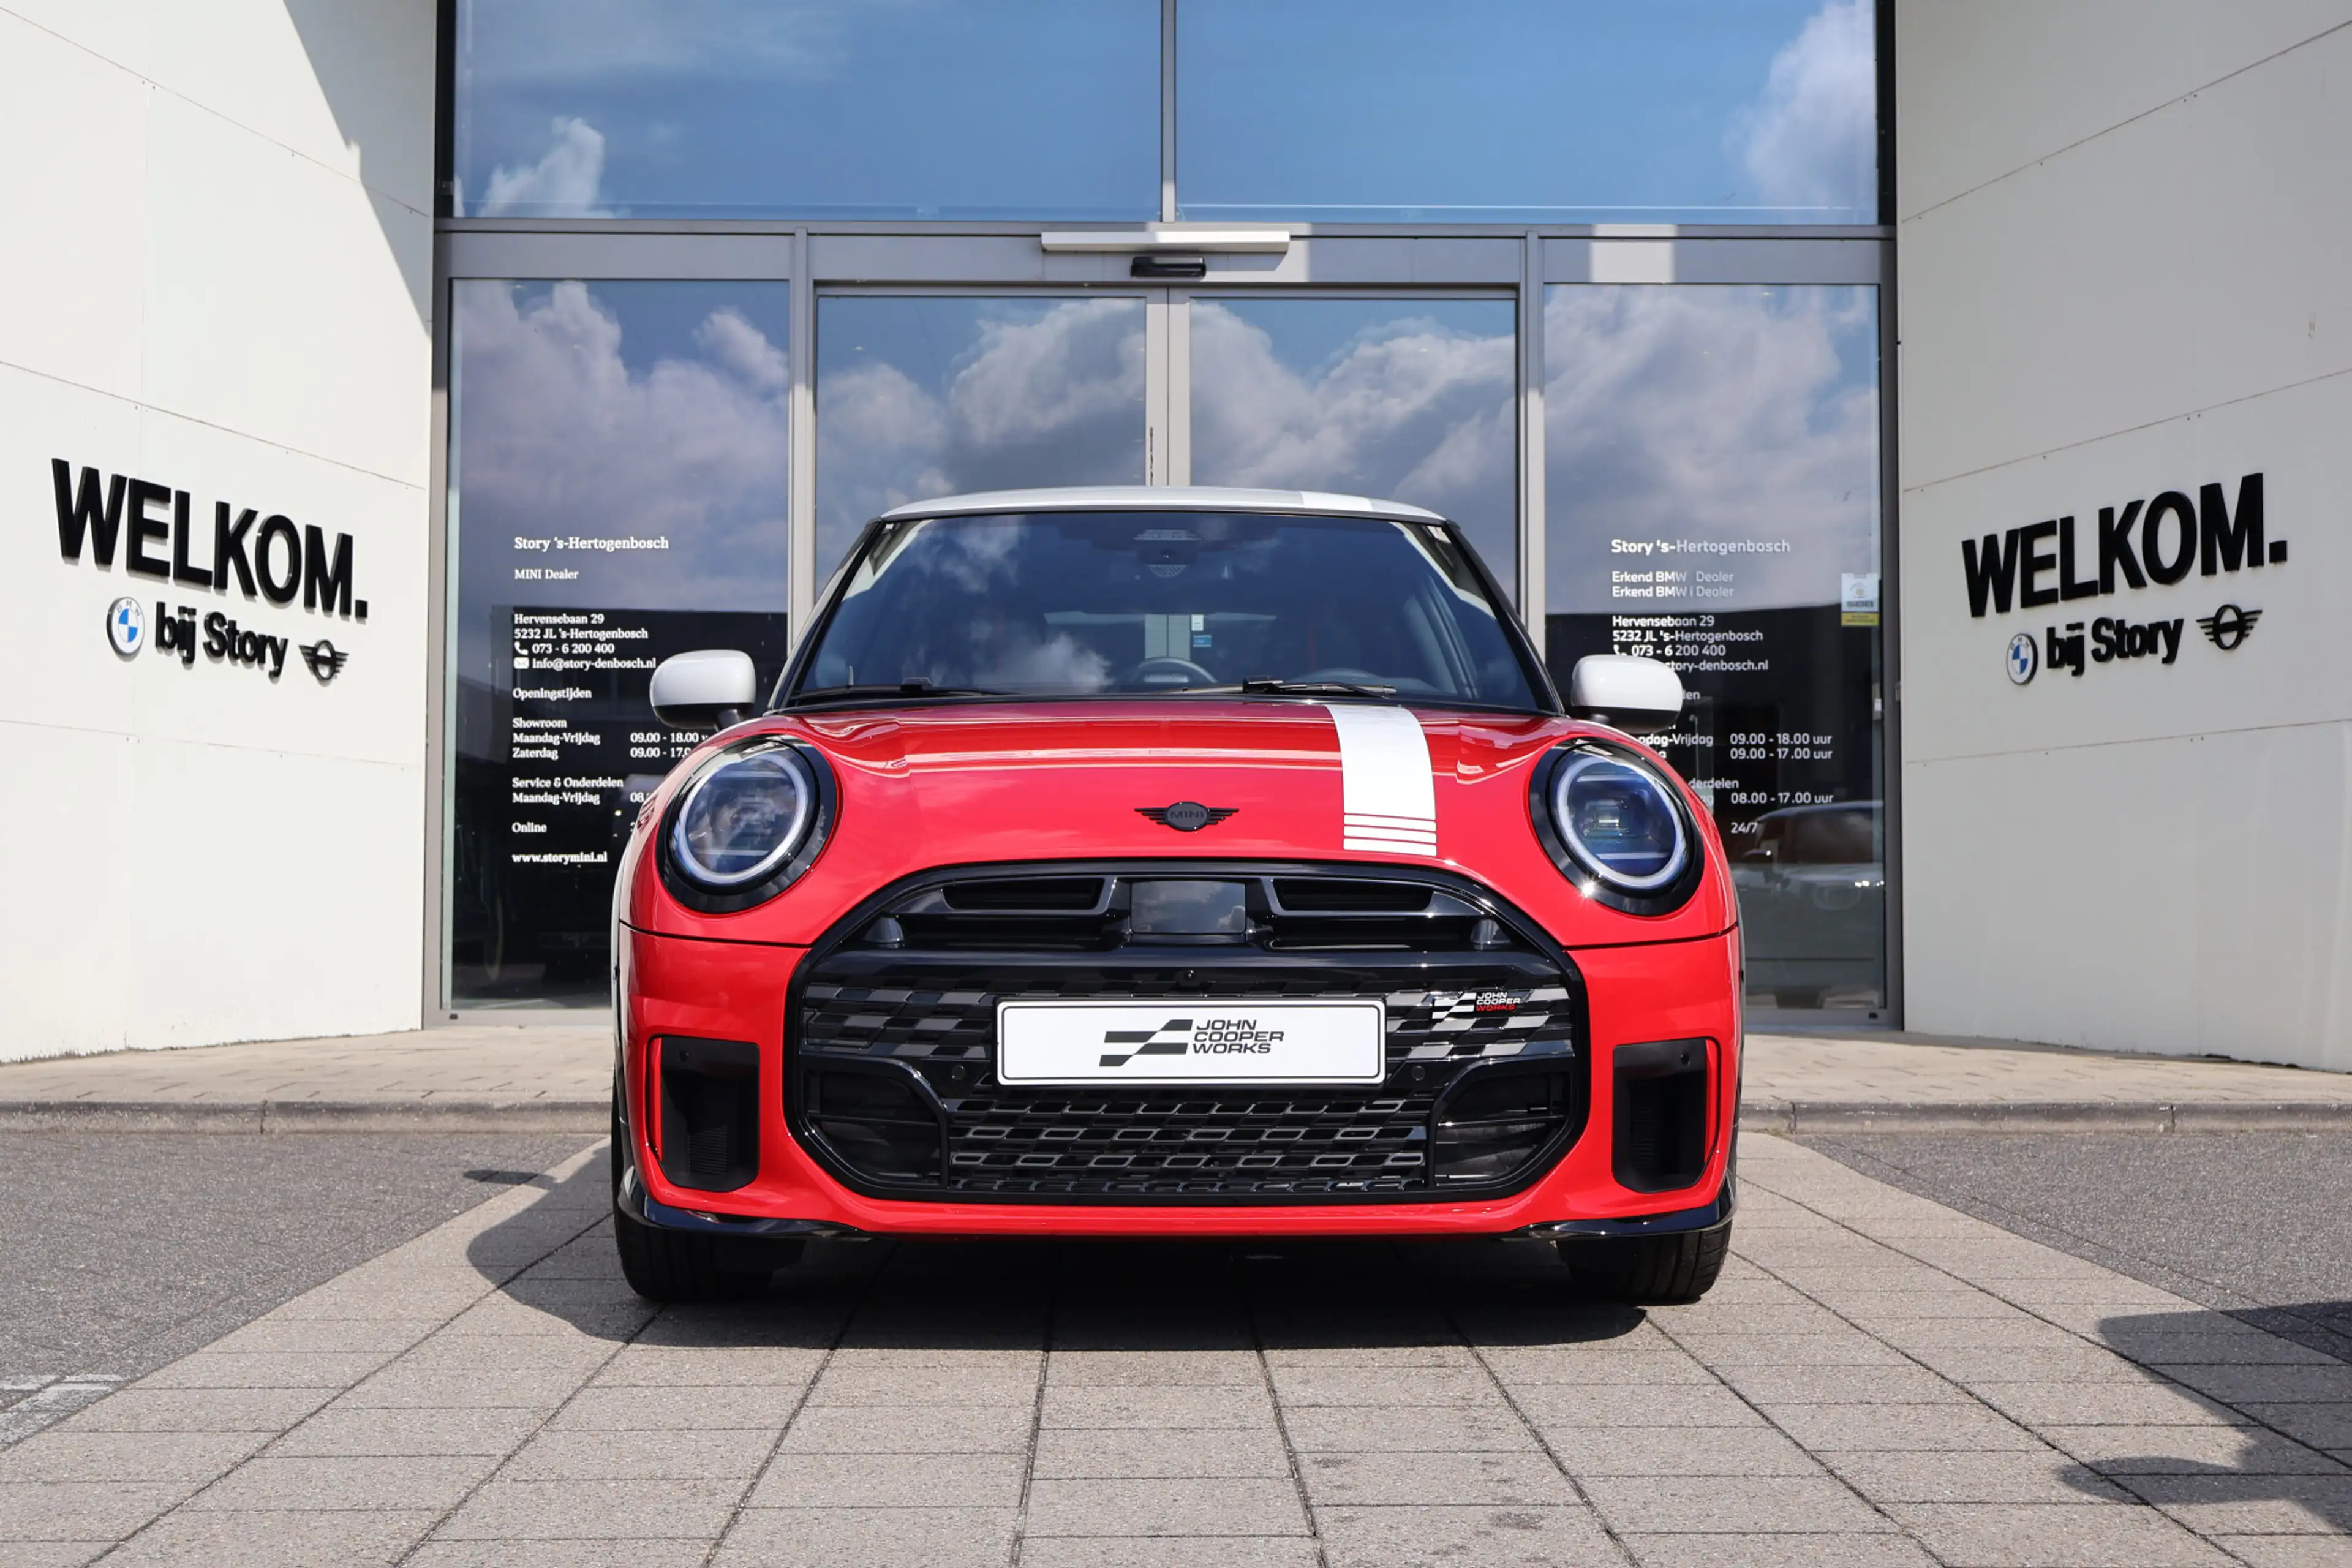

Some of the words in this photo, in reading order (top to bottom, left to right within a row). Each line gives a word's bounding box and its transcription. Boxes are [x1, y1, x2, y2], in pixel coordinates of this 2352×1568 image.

[51, 458, 368, 619] WELKOM.
[514, 537, 551, 552] Story
[1611, 539, 1654, 556] Story
[1656, 539, 1790, 555] 's-Hertogenbosch
[1962, 472, 2288, 618] WELKOM.
[514, 568, 542, 579] MINI
[545, 568, 579, 579] Dealer
[1611, 571, 1653, 582] Erkend
[1656, 571, 1687, 582] BMW
[1696, 571, 1734, 582] Dealer
[1612, 586, 1653, 597] Erkend
[1656, 586, 1687, 597] BMW
[1696, 586, 1735, 597] Dealer
[514, 613, 588, 625] Hervensebaan
[590, 613, 605, 624] 29
[1612, 615, 1697, 627] Hervensebaan
[1699, 615, 1715, 627] 29
[156, 601, 197, 664] bij
[203, 611, 289, 678] Story
[514, 628, 541, 639] 5232
[1612, 630, 1642, 642] 5232
[1643, 630, 1658, 643] JL
[1659, 630, 1763, 644] 's-Hertogenbosch
[532, 643, 552, 654] 073
[561, 643, 569, 654] 6
[571, 643, 592, 654] 200
[594, 643, 615, 654] 400
[1631, 644, 1654, 657] 073
[1664, 644, 1673, 657] 6
[1675, 644, 1699, 656] 200
[1702, 644, 1726, 656] 400
[2046, 622, 2084, 676] bij
[2090, 617, 2184, 665] Story
[532, 657, 656, 671] info@story-denbosch.nl
[1666, 659, 1769, 673] tory-denbosch.nl
[512, 687, 592, 700] Openingstijden
[512, 717, 567, 729] Showroom
[512, 732, 601, 745] Maandag-Vrijdag
[630, 732, 661, 744] 09.00
[670, 732, 699, 744] 18.00
[1730, 733, 1765, 745] 09.00
[1776, 733, 1810, 745] 18.00
[1812, 735, 1832, 745] uur
[512, 747, 559, 760] Zaterdag
[630, 747, 661, 758] 09.00
[1730, 747, 1766, 760] 09.00
[1813, 750, 1833, 760] uur
[512, 777, 552, 788] Service
[554, 777, 562, 788] &
[563, 777, 624, 788] Onderdelen
[1688, 777, 1739, 790] derdelen
[512, 791, 600, 805] Maandag-Vrijdag
[1731, 792, 1767, 804] 08.00
[1814, 794, 1834, 804] uur
[1170, 810, 1204, 819] MINI
[512, 821, 548, 833] Online
[1731, 821, 1757, 834] 24/7
[512, 851, 608, 863] www.storymini.nl
[1196, 1019, 1257, 1031] JOHN
[1194, 1031, 1284, 1042] COOPER
[1193, 1043, 1271, 1054] WORKS
